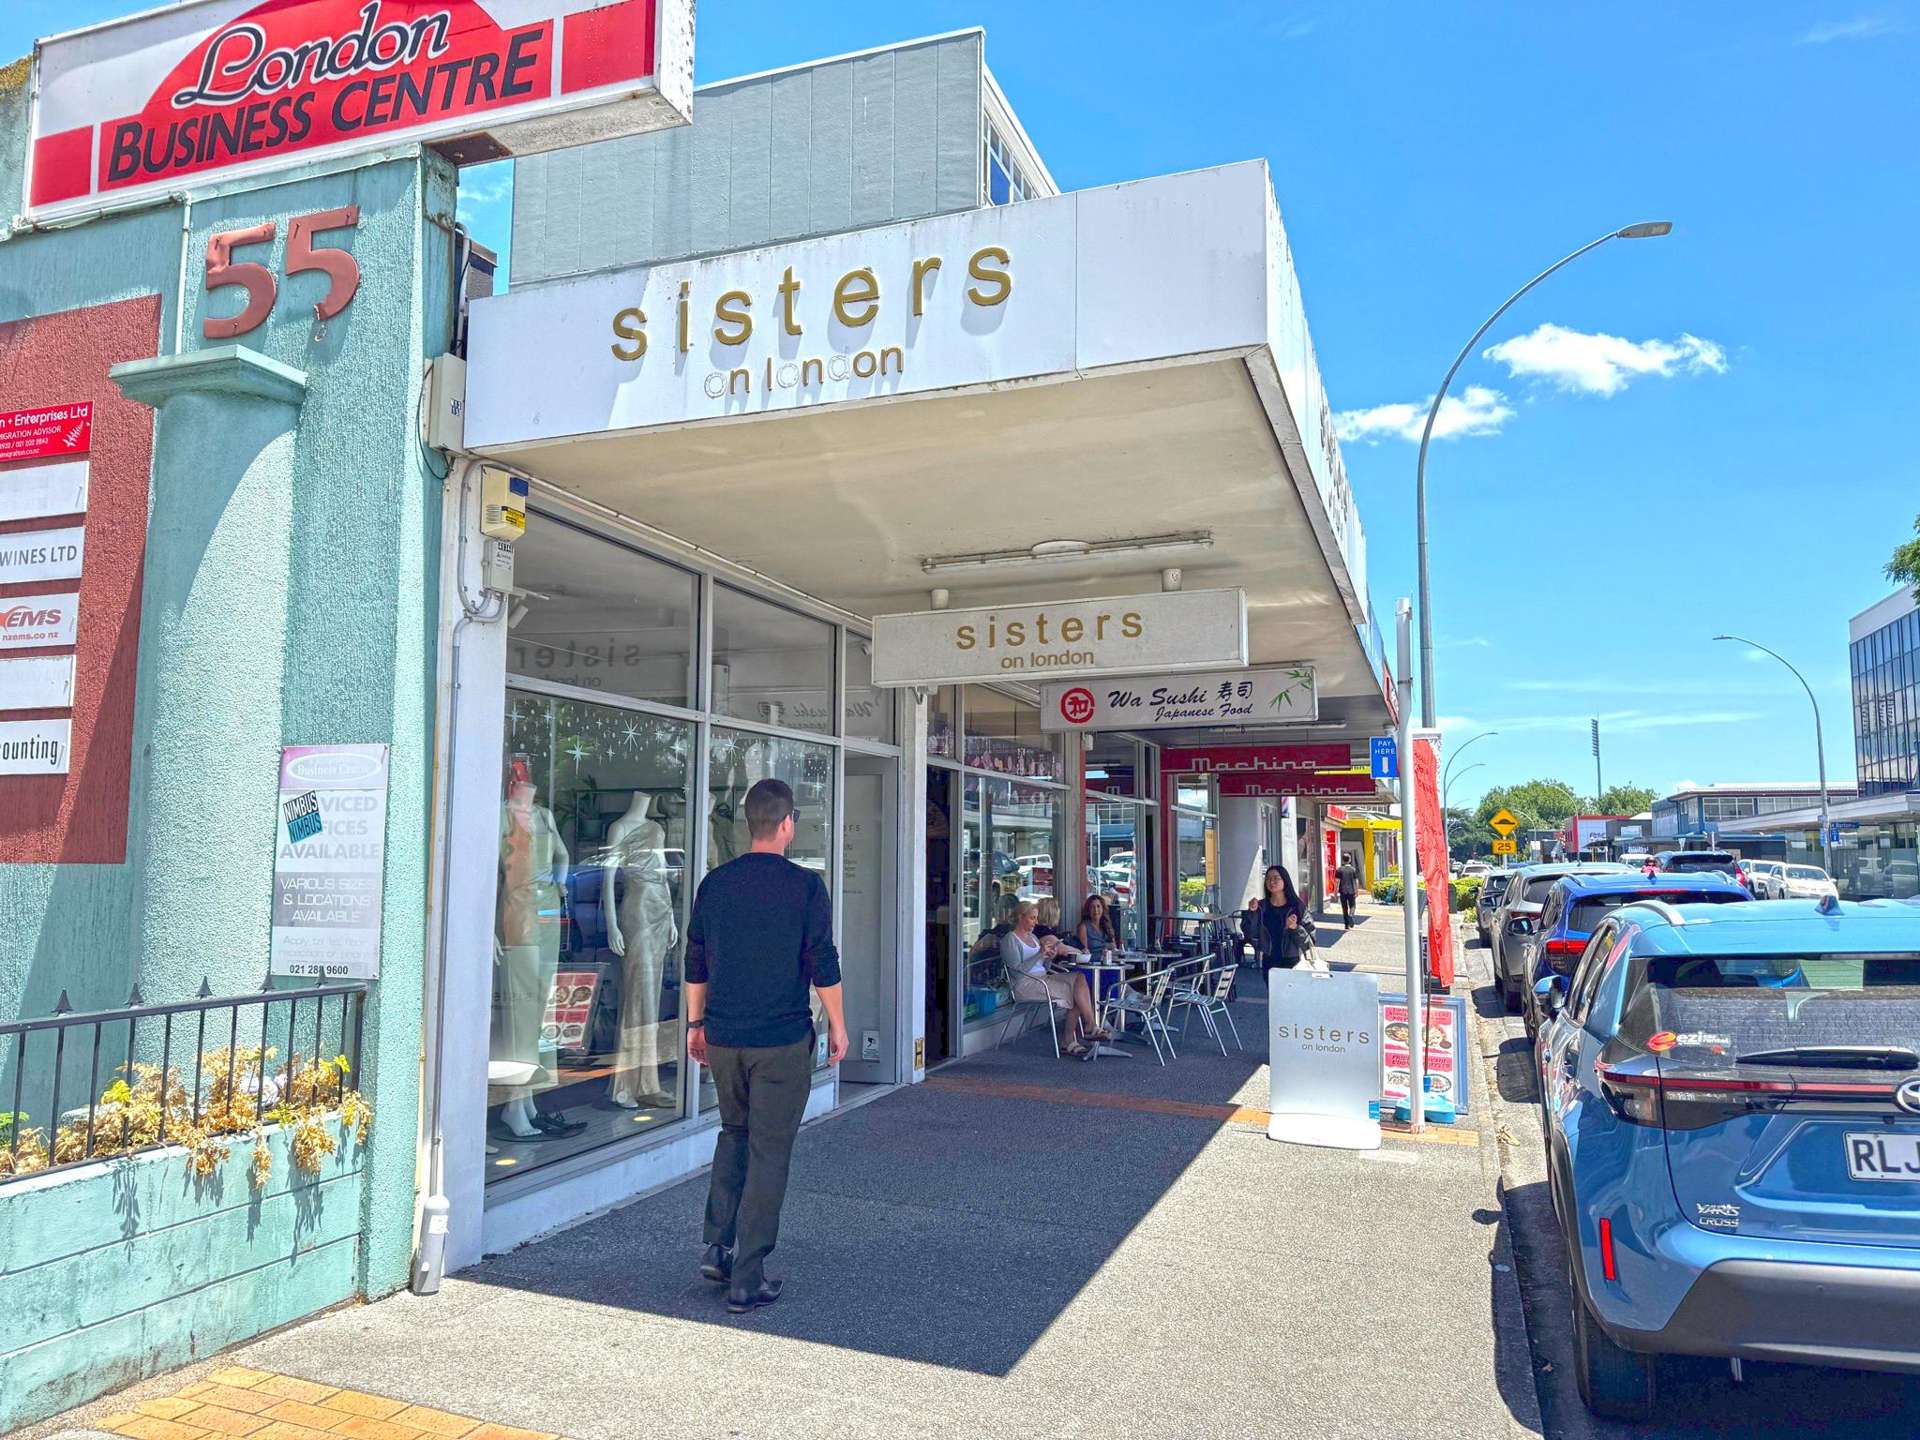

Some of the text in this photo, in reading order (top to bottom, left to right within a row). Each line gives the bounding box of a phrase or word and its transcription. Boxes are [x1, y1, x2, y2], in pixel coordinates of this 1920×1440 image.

[172, 0, 451, 107] London
[107, 28, 545, 183] BUSINESS CENTRE
[203, 205, 360, 339] 55
[611, 246, 1013, 362] sisters
[14, 410, 68, 426] Enterprises
[70, 406, 88, 419] Ltd
[33, 425, 62, 436] ADVISOR
[0, 545, 77, 567] WINES LTD
[956, 610, 1144, 650] sisters
[1001, 649, 1094, 669] on london
[1108, 687, 1207, 710] Wa Sushi
[1217, 680, 1253, 700] 寿司
[1155, 702, 1254, 723] Japanese Food
[283, 790, 319, 823] NIMBUS
[320, 796, 379, 813] VICED
[287, 811, 323, 844] NIMBUS
[279, 843, 381, 860] AVAILABLE
[1496, 842, 1512, 852] 25
[282, 893, 371, 906] & LOCATIONS
[291, 910, 361, 923] AVAILABLE
[289, 964, 305, 974] 021
[326, 965, 349, 975] 9600
[1278, 1023, 1370, 1044] sisters
[1676, 1031, 1703, 1044] ezi
[1302, 1043, 1346, 1053] on london
[1852, 1140, 1920, 1174] RLJ
[1696, 1203, 1741, 1217] YARIS
[1699, 1216, 1740, 1228] CROSS
